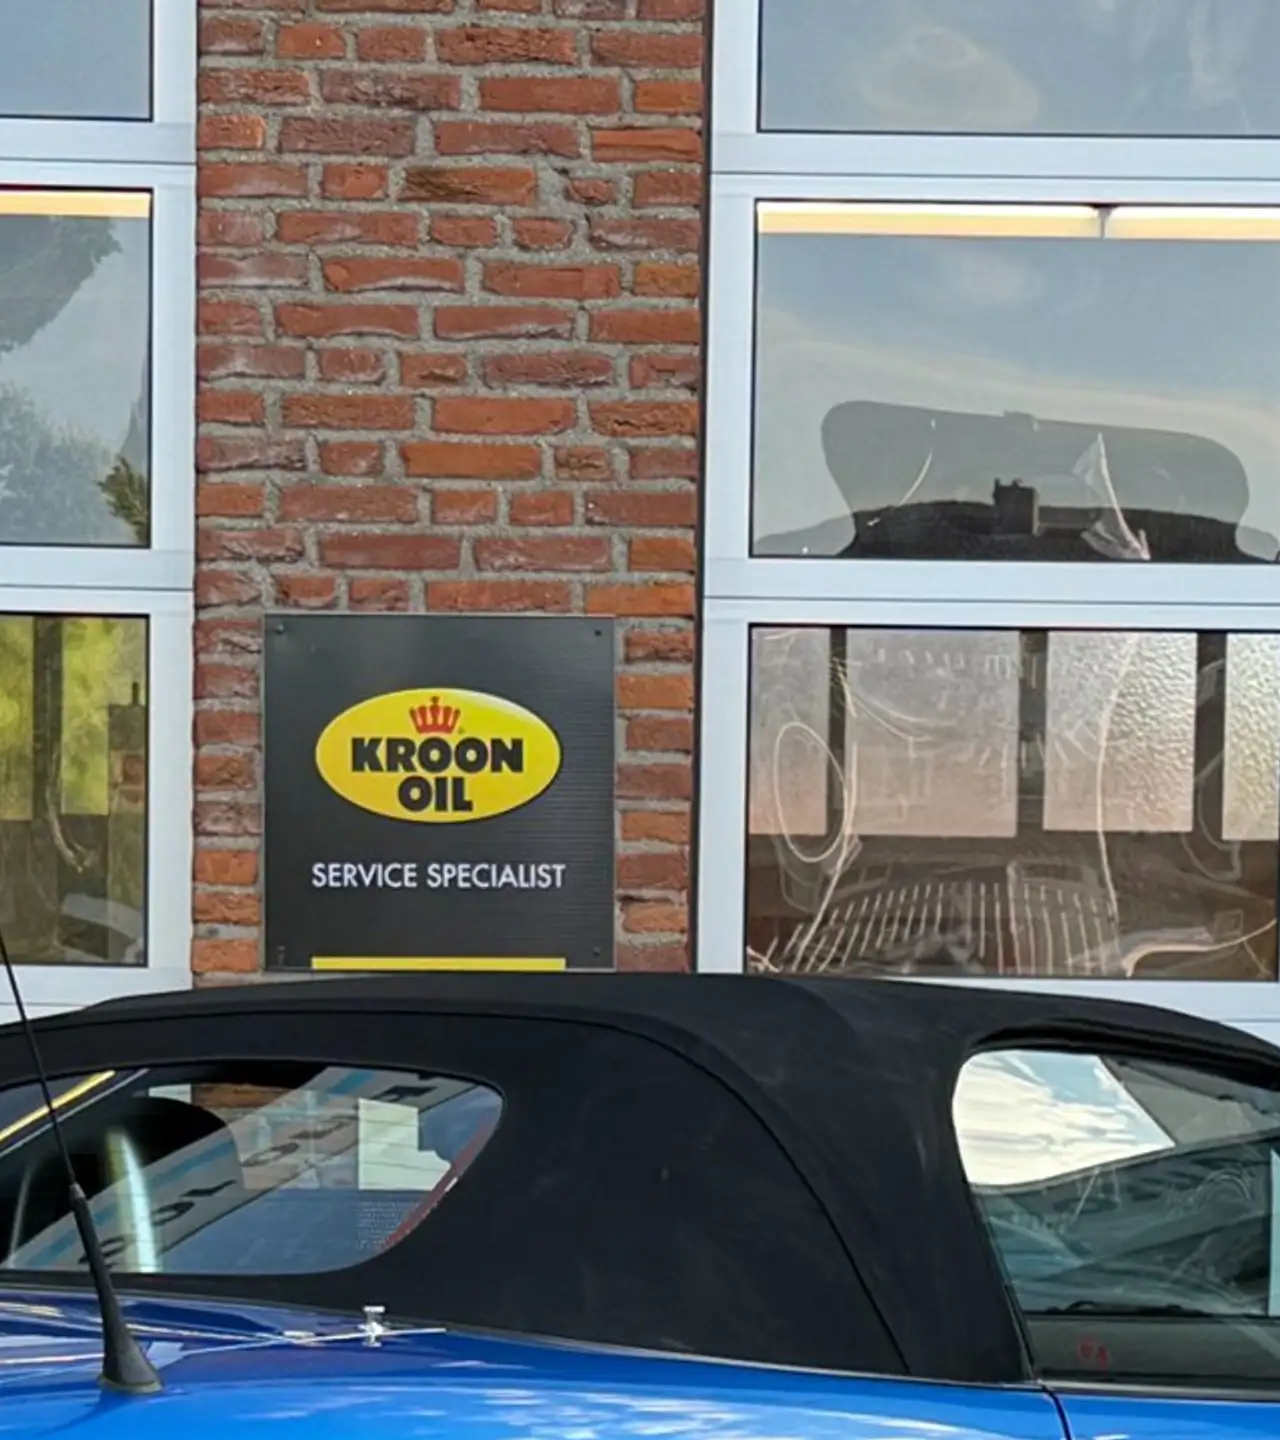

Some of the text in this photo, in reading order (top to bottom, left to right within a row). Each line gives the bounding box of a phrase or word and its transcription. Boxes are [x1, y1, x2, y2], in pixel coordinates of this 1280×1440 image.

[351, 737, 524, 773] KROON
[398, 775, 474, 812] OIL
[311, 862, 566, 890] SERVICE SPECIALIST
